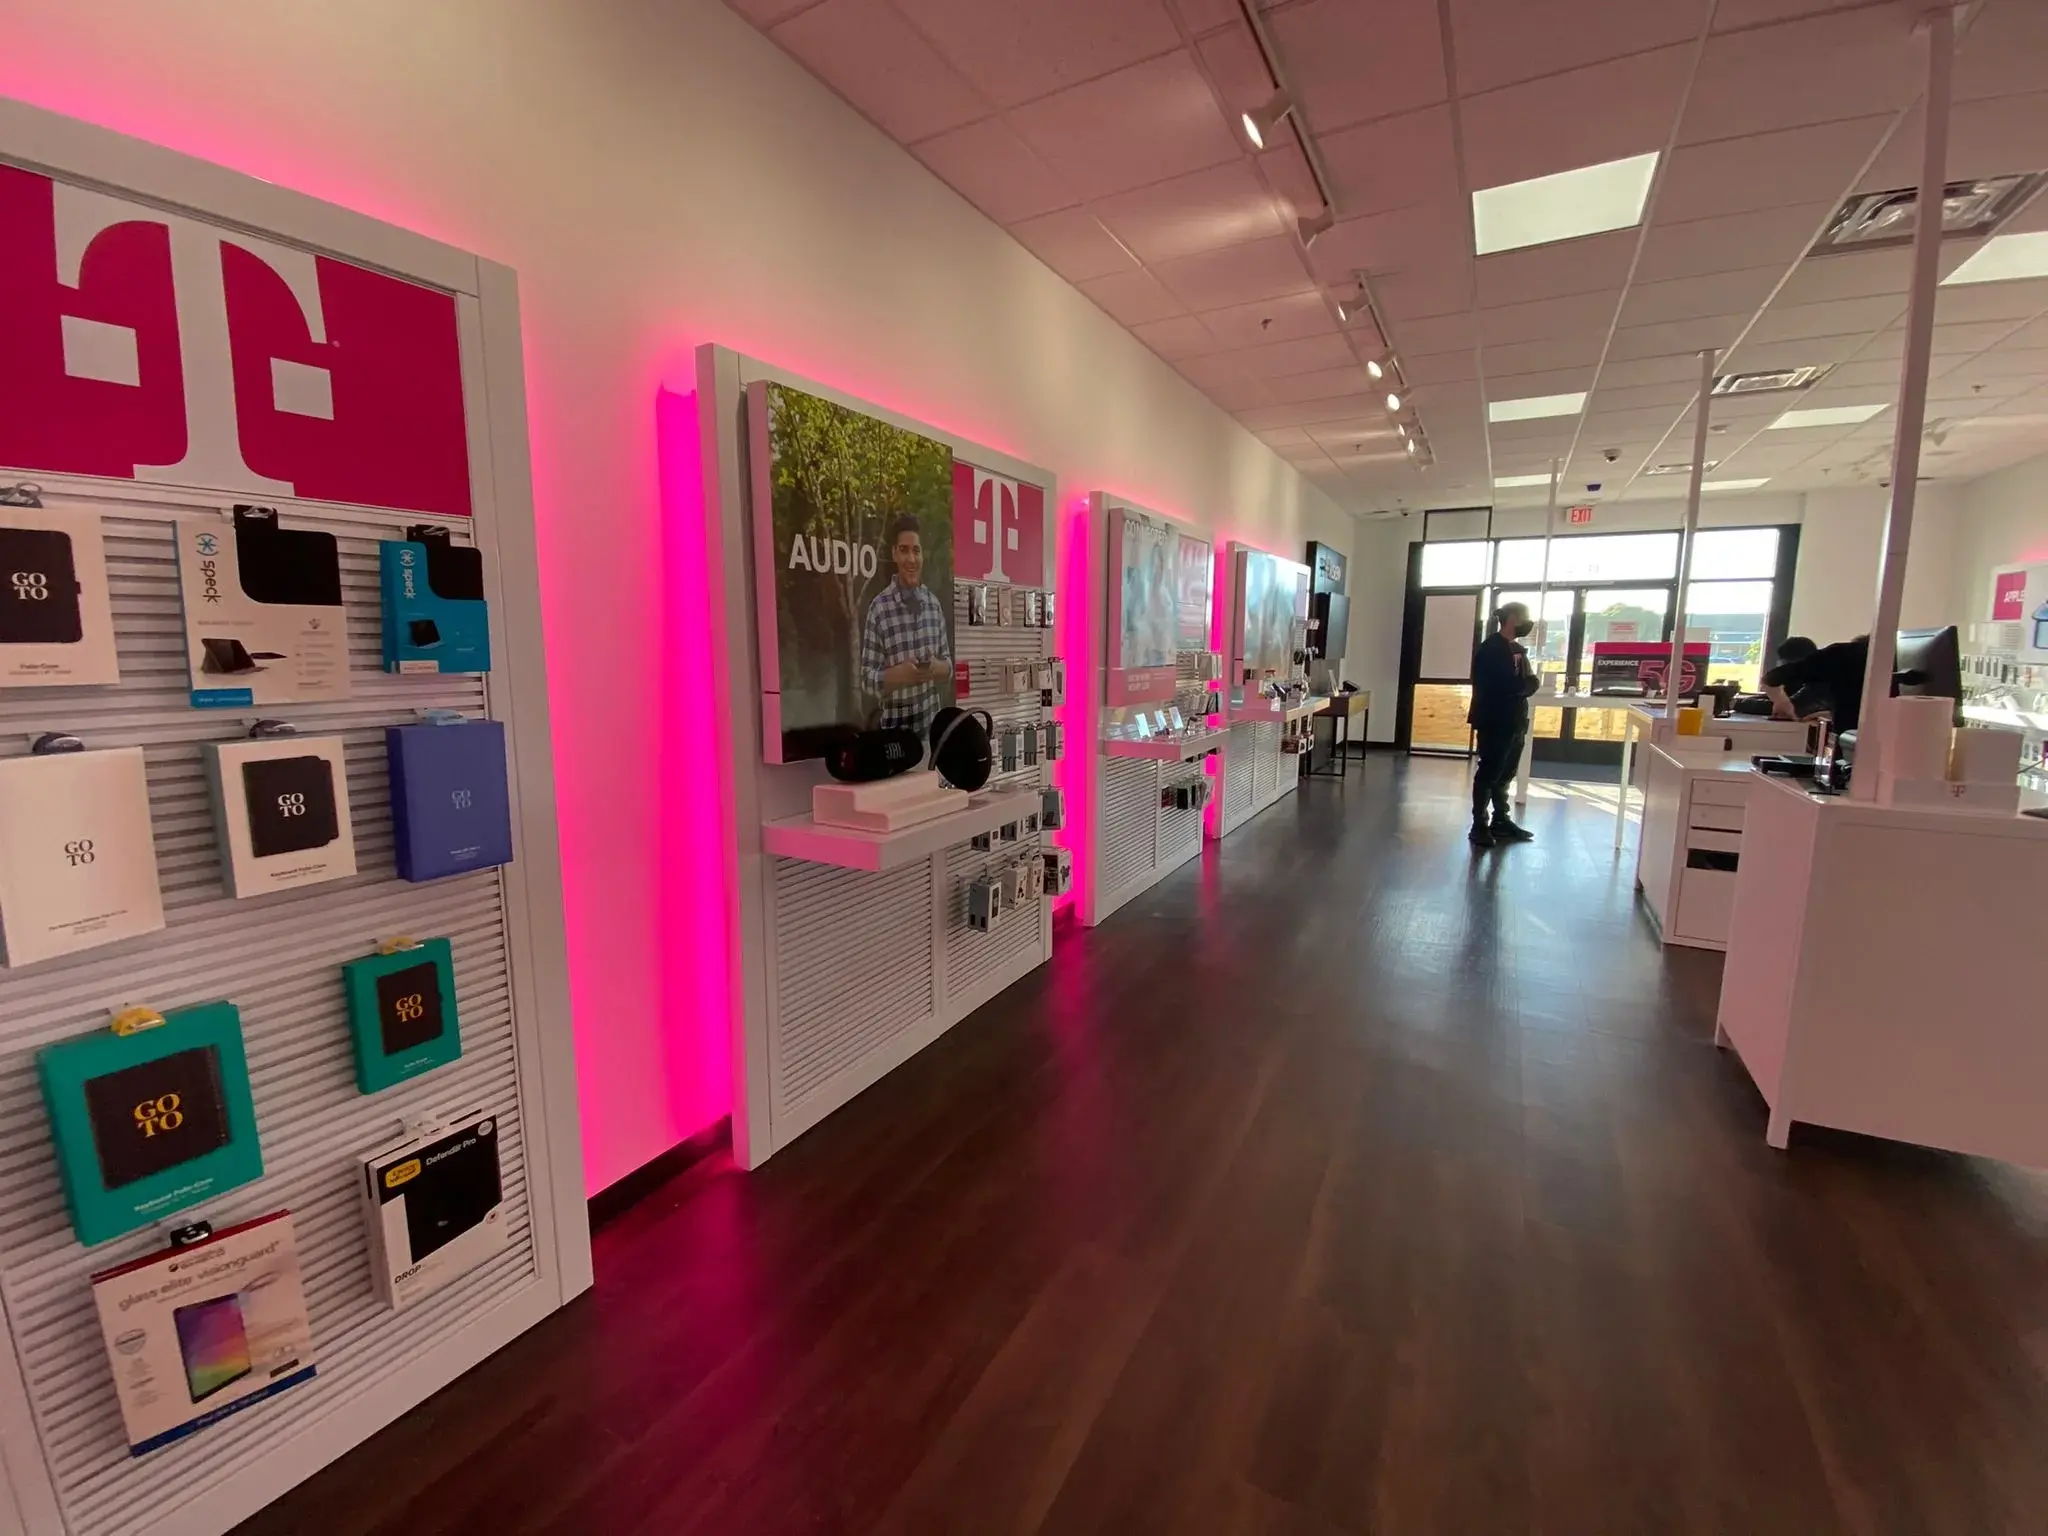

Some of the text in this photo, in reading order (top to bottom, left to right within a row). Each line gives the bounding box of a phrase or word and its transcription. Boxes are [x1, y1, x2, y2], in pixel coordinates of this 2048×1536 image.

[1571, 508, 1592, 522] EXIT
[789, 534, 877, 579] AUDIO
[12, 572, 47, 588] GO
[200, 560, 221, 603] speck
[402, 569, 416, 599] speck
[14, 586, 48, 600] TO
[1598, 659, 1639, 667] EXPERIENCE
[278, 792, 304, 807] GO
[451, 789, 471, 801] GO
[280, 804, 306, 818] TO
[454, 798, 472, 810] TO
[64, 839, 94, 854] GO
[66, 852, 95, 866] TO
[395, 993, 422, 1011] GO
[397, 1006, 424, 1022] TO
[133, 1091, 182, 1120] GO
[138, 1111, 184, 1138] TO
[426, 1138, 477, 1166] Defender Pro
[394, 1264, 422, 1285] DROP
